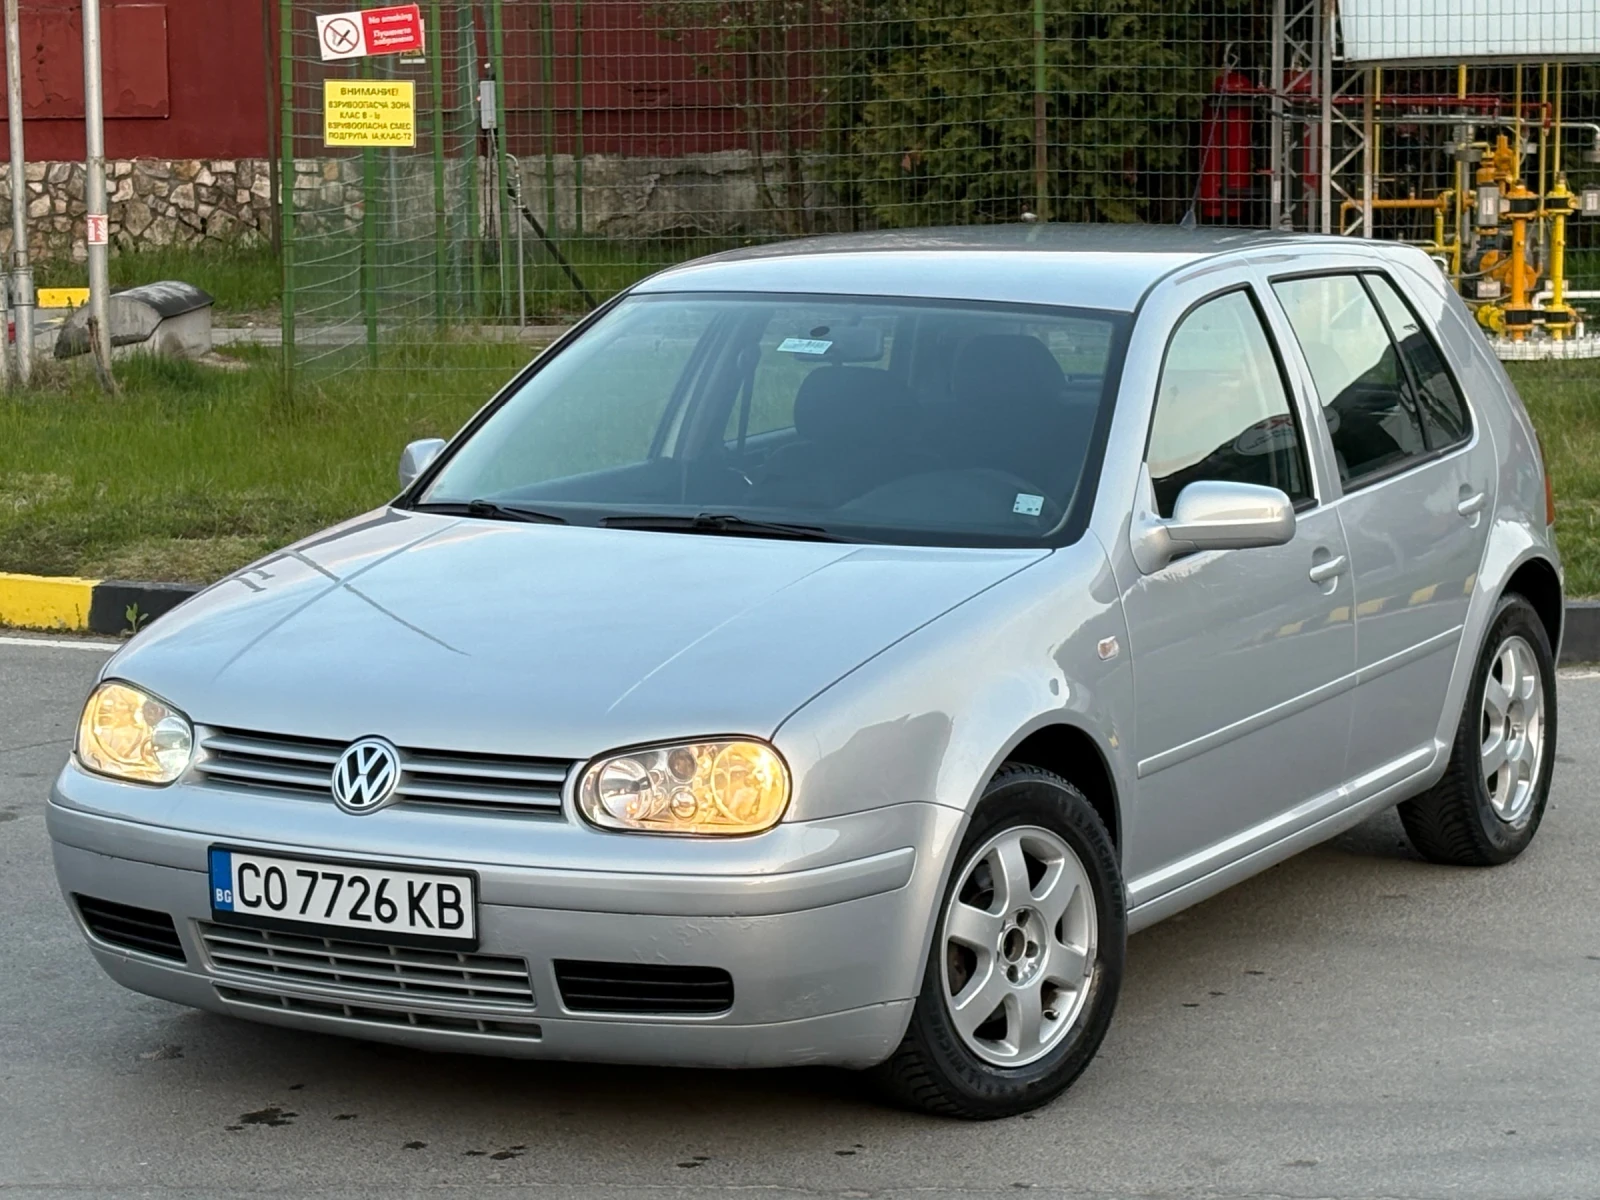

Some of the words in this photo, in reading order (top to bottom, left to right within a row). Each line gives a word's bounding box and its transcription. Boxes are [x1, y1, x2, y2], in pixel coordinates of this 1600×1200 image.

[368, 16, 380, 24] No
[381, 13, 413, 23] smoking
[340, 87, 399, 96] ВНИМАНИЕ!
[390, 101, 411, 109] ЗОНА
[339, 111, 360, 119] КЛАС
[328, 121, 388, 130] ВЗРИВООПАСНА
[389, 122, 411, 130] СМЕС
[328, 132, 368, 140] ПОДГРУПА
[333, 741, 398, 809] VW
[215, 888, 232, 903] BG
[296, 868, 398, 923] 7726
[407, 880, 465, 930] KB
